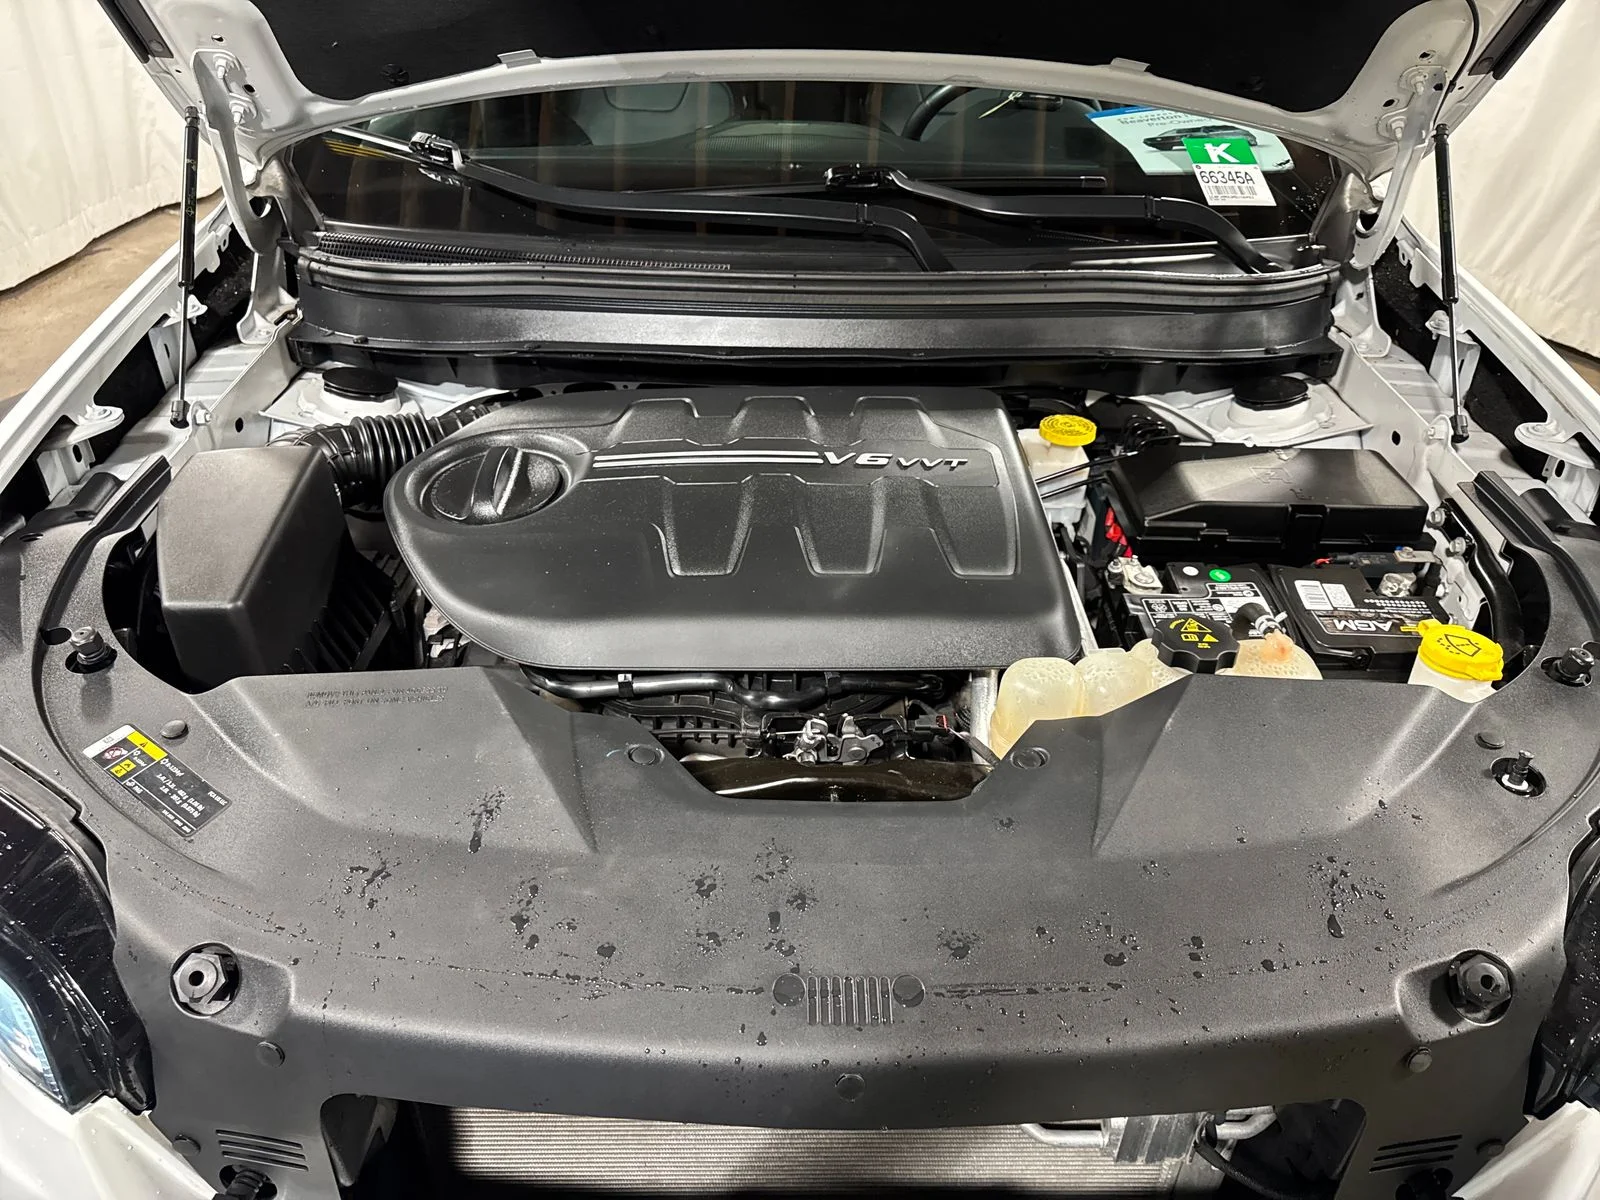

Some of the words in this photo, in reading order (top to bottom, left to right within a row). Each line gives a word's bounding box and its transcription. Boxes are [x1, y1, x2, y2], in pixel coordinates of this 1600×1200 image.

[1204, 143, 1240, 163] K
[1200, 171, 1255, 184] 66345A
[824, 451, 893, 466] V6
[897, 457, 968, 470] VVT
[1333, 619, 1393, 632] AGM
